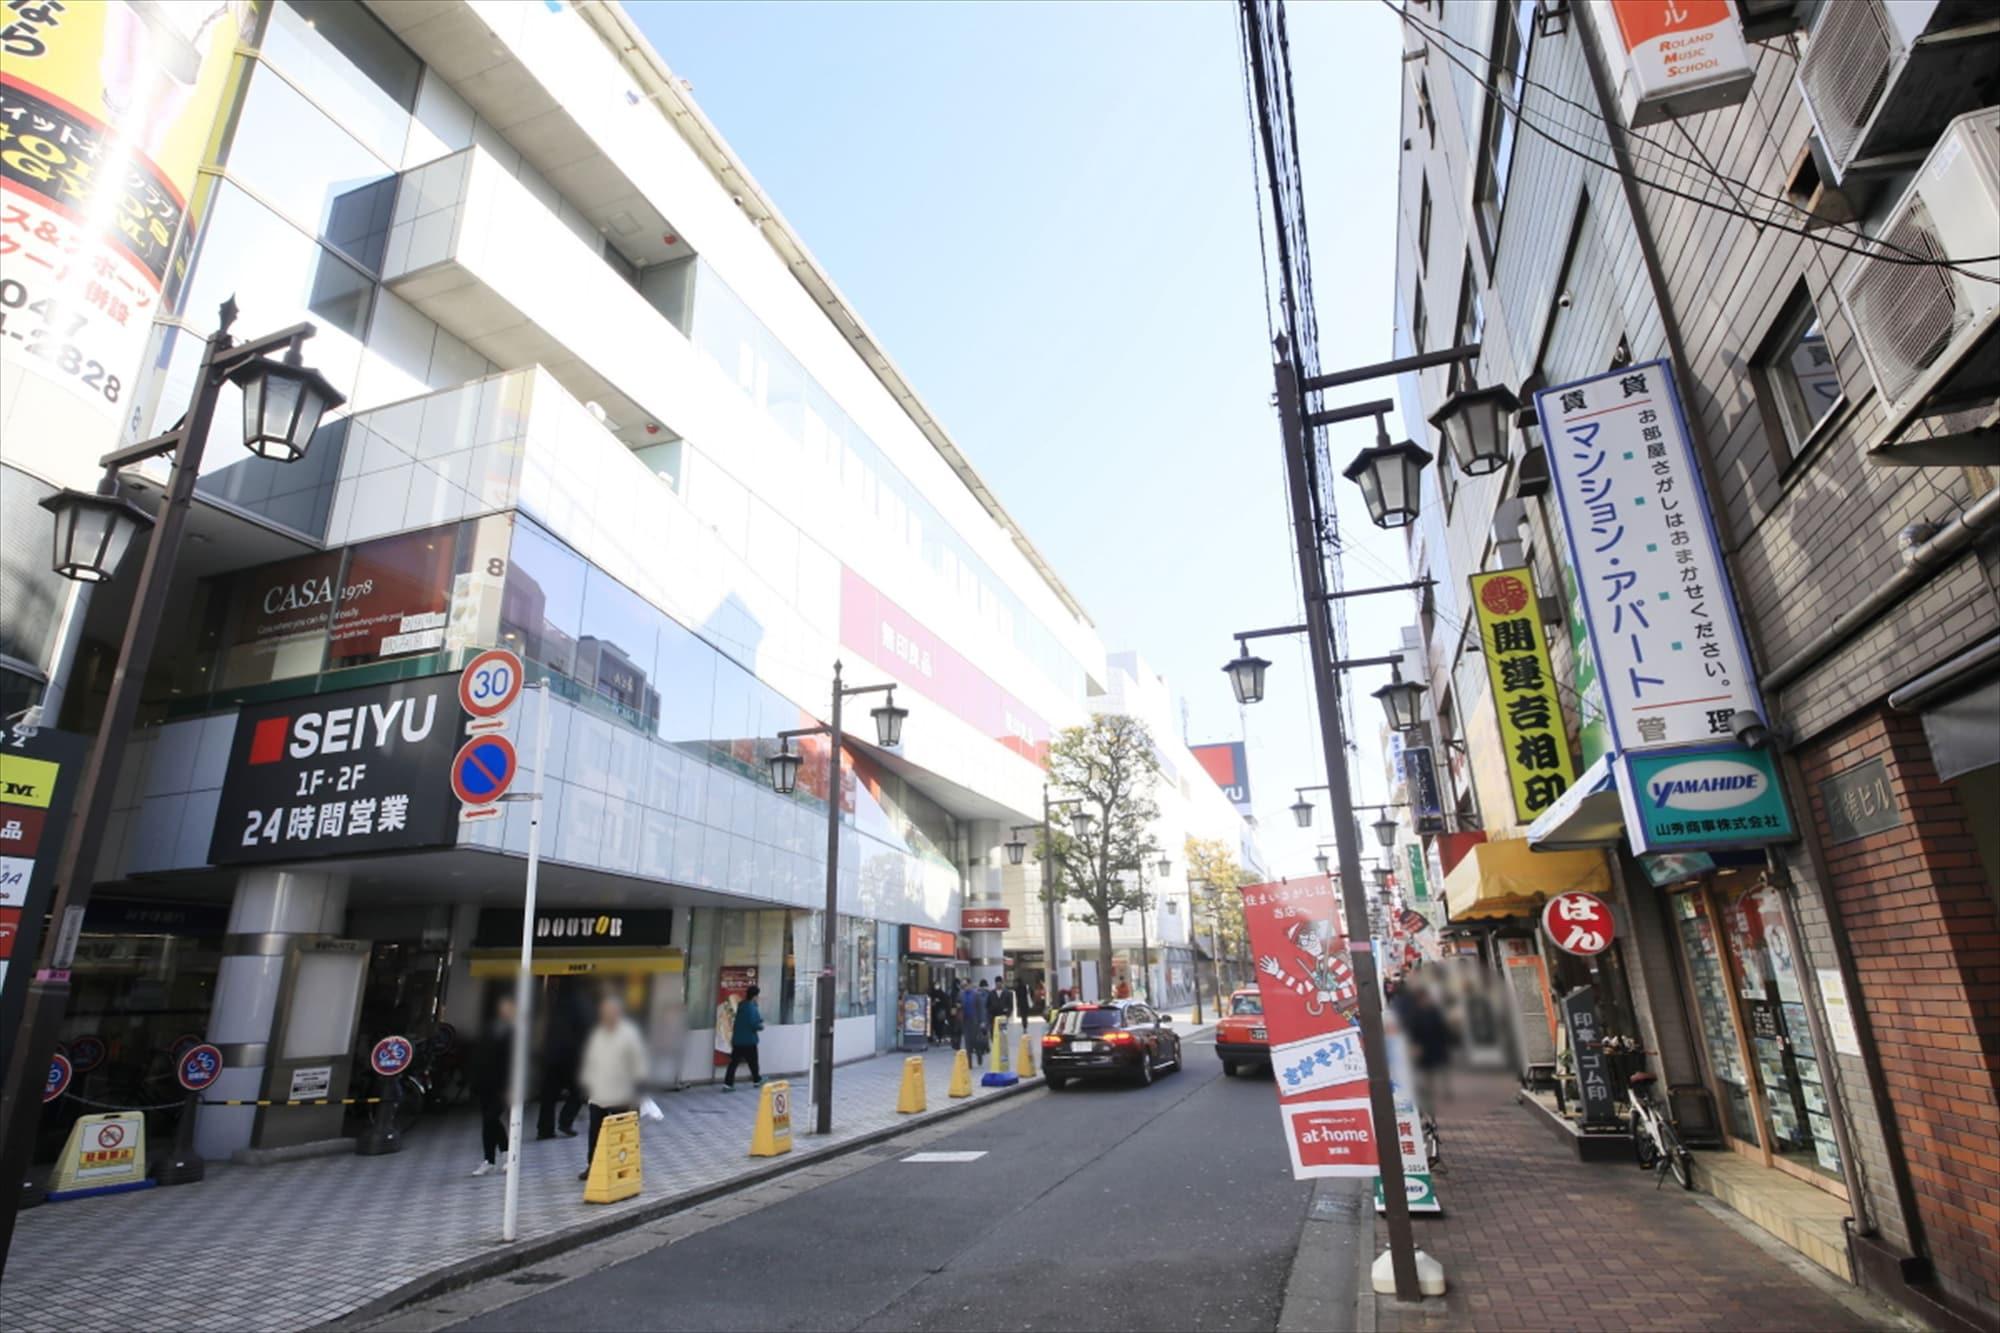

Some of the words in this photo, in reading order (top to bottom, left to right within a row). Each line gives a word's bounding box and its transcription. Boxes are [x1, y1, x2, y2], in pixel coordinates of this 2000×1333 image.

[1660, 32, 1714, 52] ROLAND
[1664, 48, 1705, 64] MUSIC
[1667, 58, 1720, 77] SCHOOL
[1566, 422, 1665, 698] マンション・アパート
[1638, 409, 1731, 688] お部屋さがしはおまかせください。
[486, 557, 504, 577] 8
[264, 576, 334, 615] CASA
[340, 579, 374, 601] 1978
[474, 668, 509, 699] 30
[289, 695, 437, 759] SEIYU
[1491, 617, 1568, 812] 開運吉相印
[1653, 774, 1759, 808] YAMAHIDE
[241, 794, 409, 846] 24時間営業
[1656, 815, 1780, 837] 山秀商事株式会社
[537, 915, 623, 937] DOUTOR
[1558, 895, 1605, 951] はん
[1302, 1129, 1320, 1144] at
[1320, 1125, 1369, 1143] home
